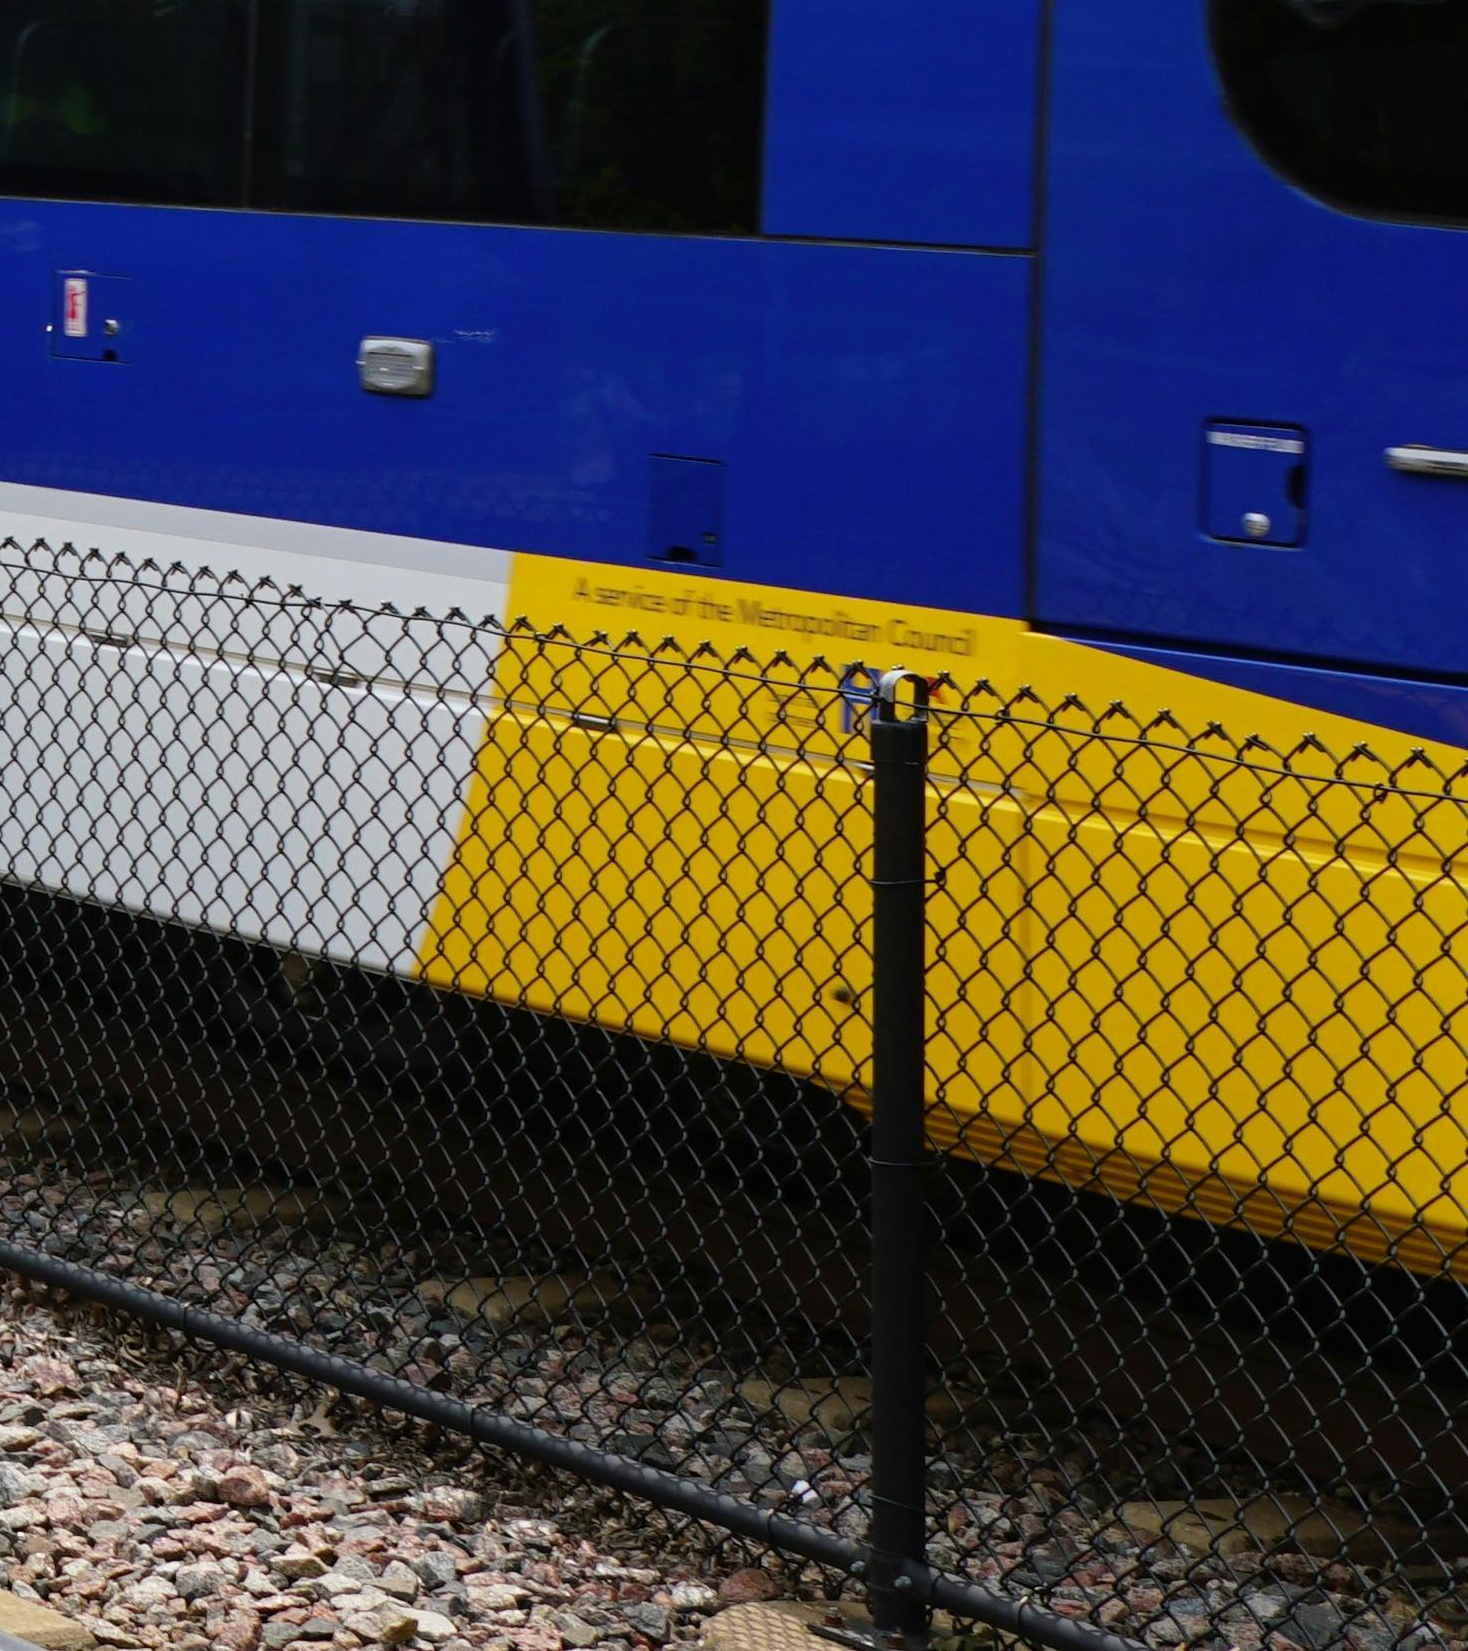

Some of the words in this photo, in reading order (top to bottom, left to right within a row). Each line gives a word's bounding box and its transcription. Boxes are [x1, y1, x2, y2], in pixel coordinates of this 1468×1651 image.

[572, 577, 591, 603] A
[593, 584, 665, 614] service
[669, 589, 699, 615] of
[698, 591, 732, 623] the
[736, 597, 882, 644] Metropolitan
[886, 617, 976, 657] Council
